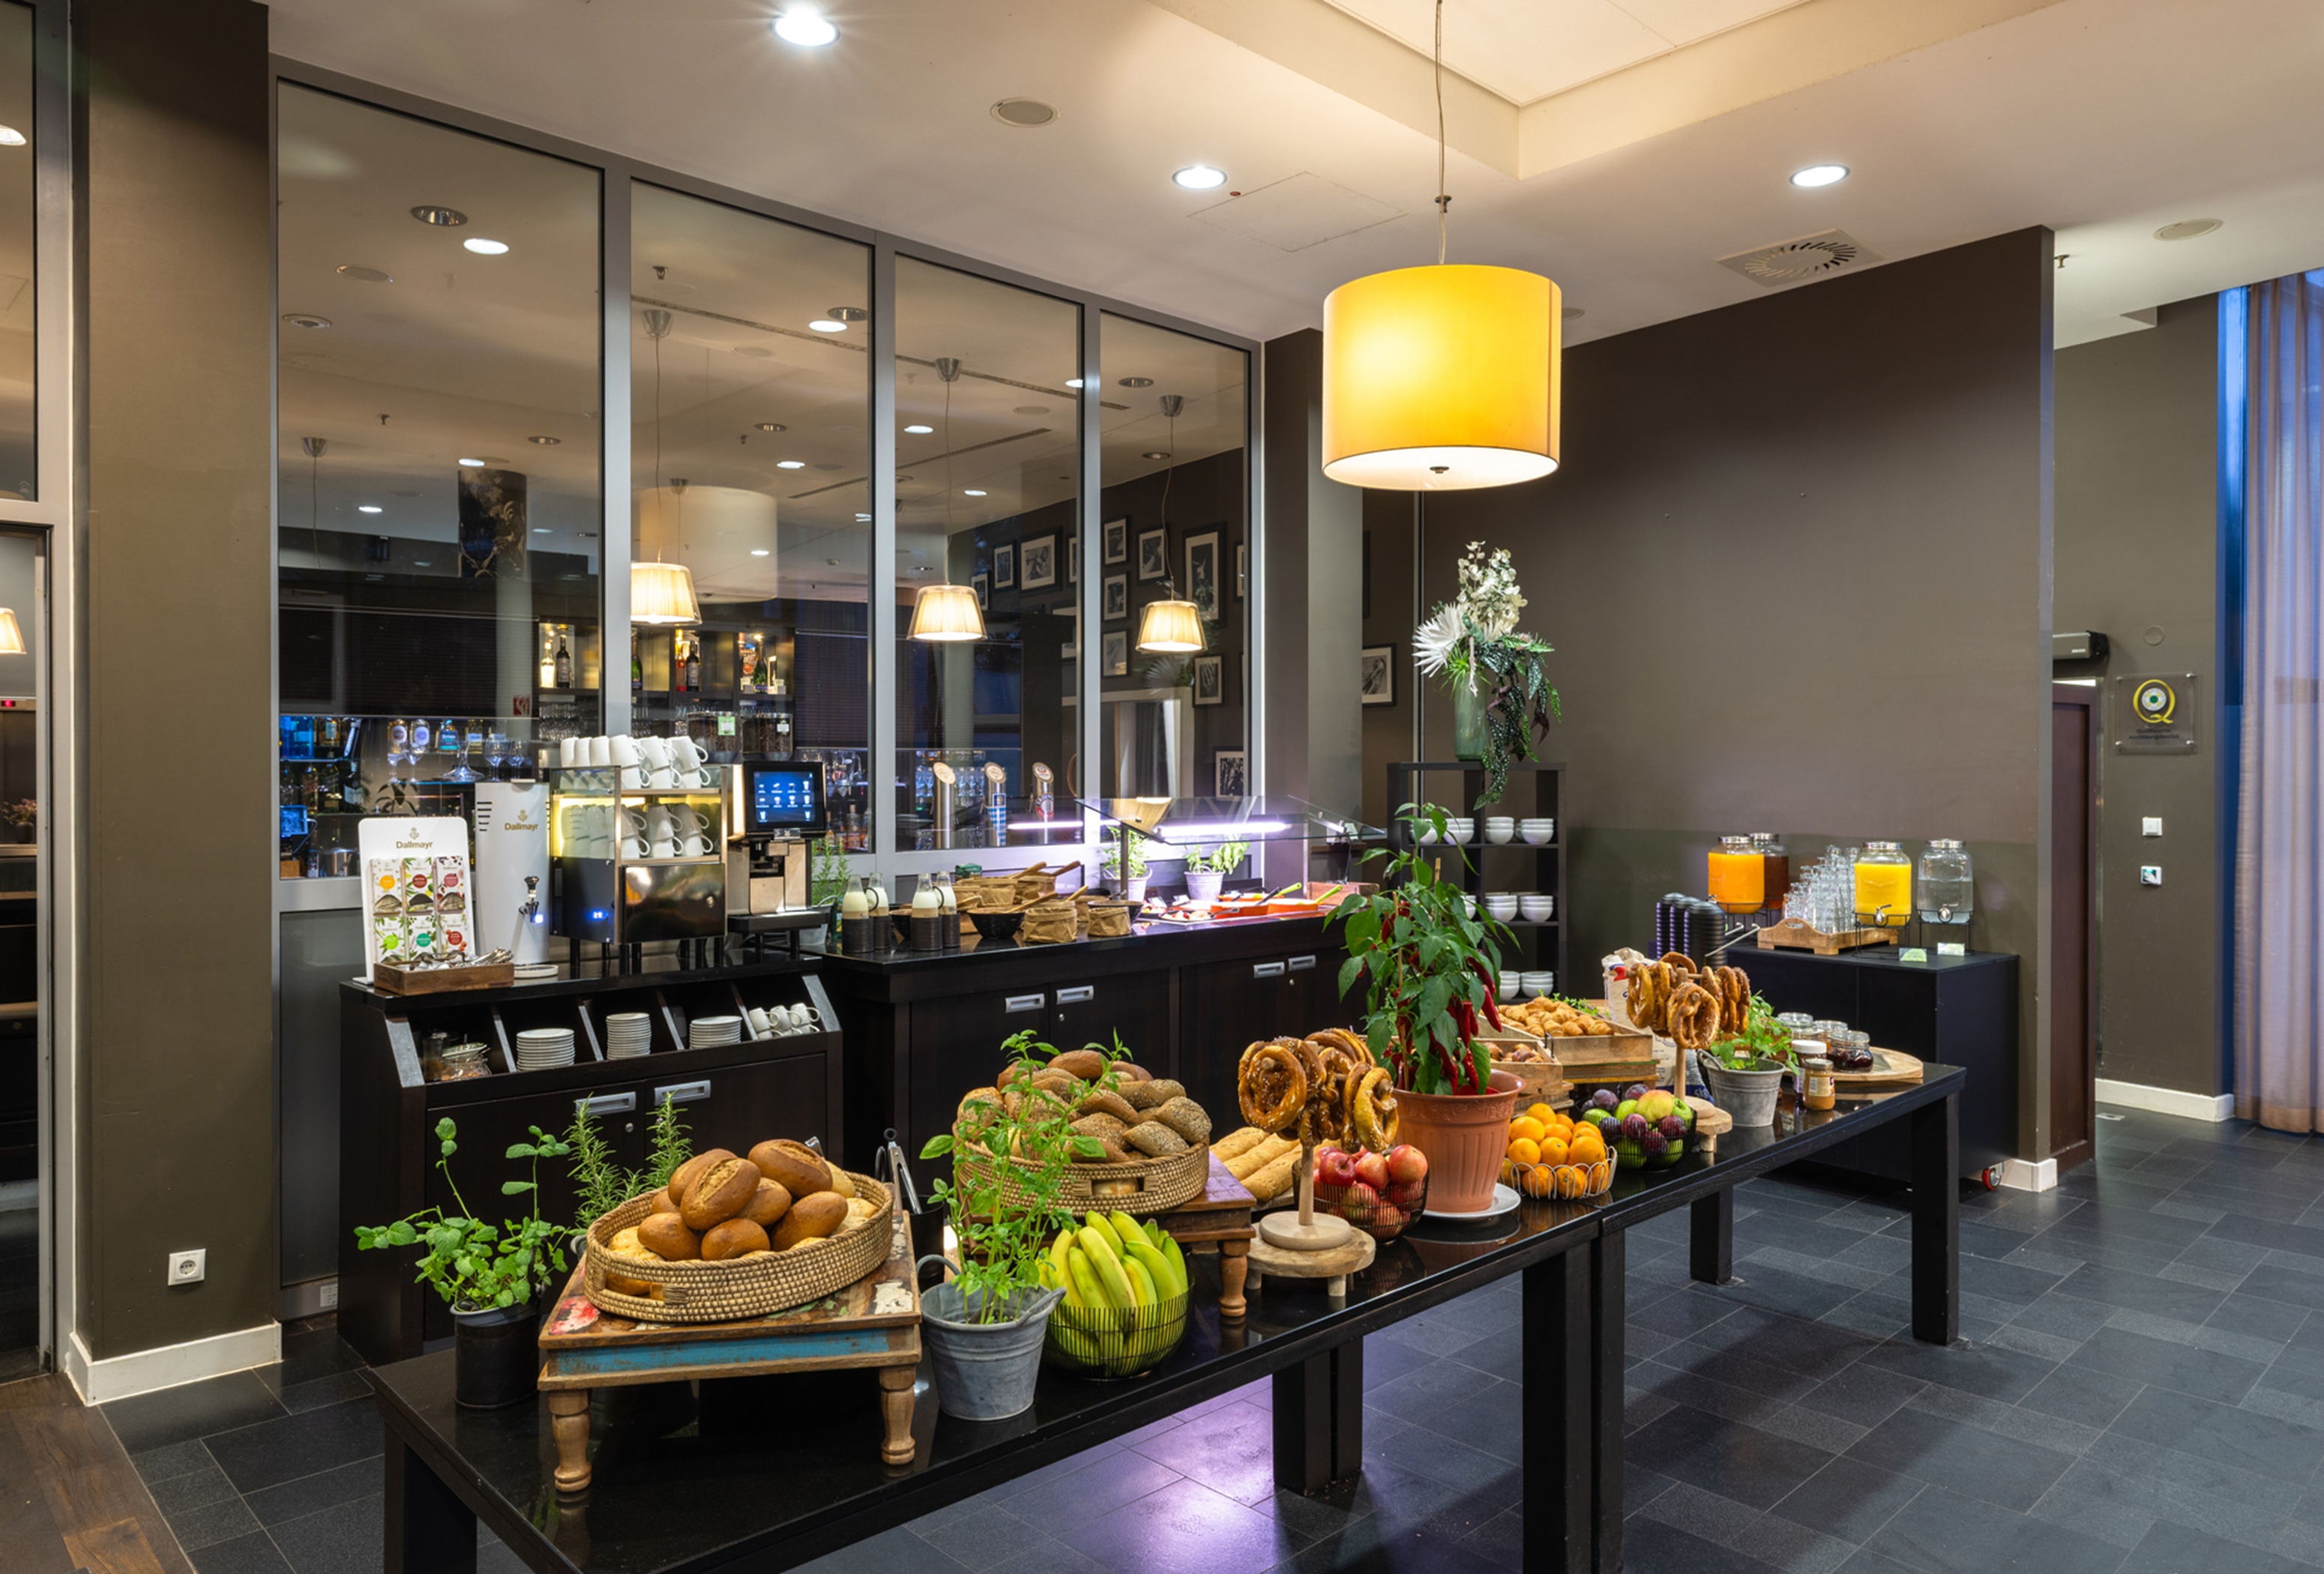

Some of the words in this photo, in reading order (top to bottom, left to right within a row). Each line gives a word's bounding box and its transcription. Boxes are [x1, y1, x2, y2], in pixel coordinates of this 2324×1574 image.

[2133, 679, 2176, 724] Q
[505, 822, 539, 832] Dallmayr
[396, 840, 433, 850] Dallmayr
